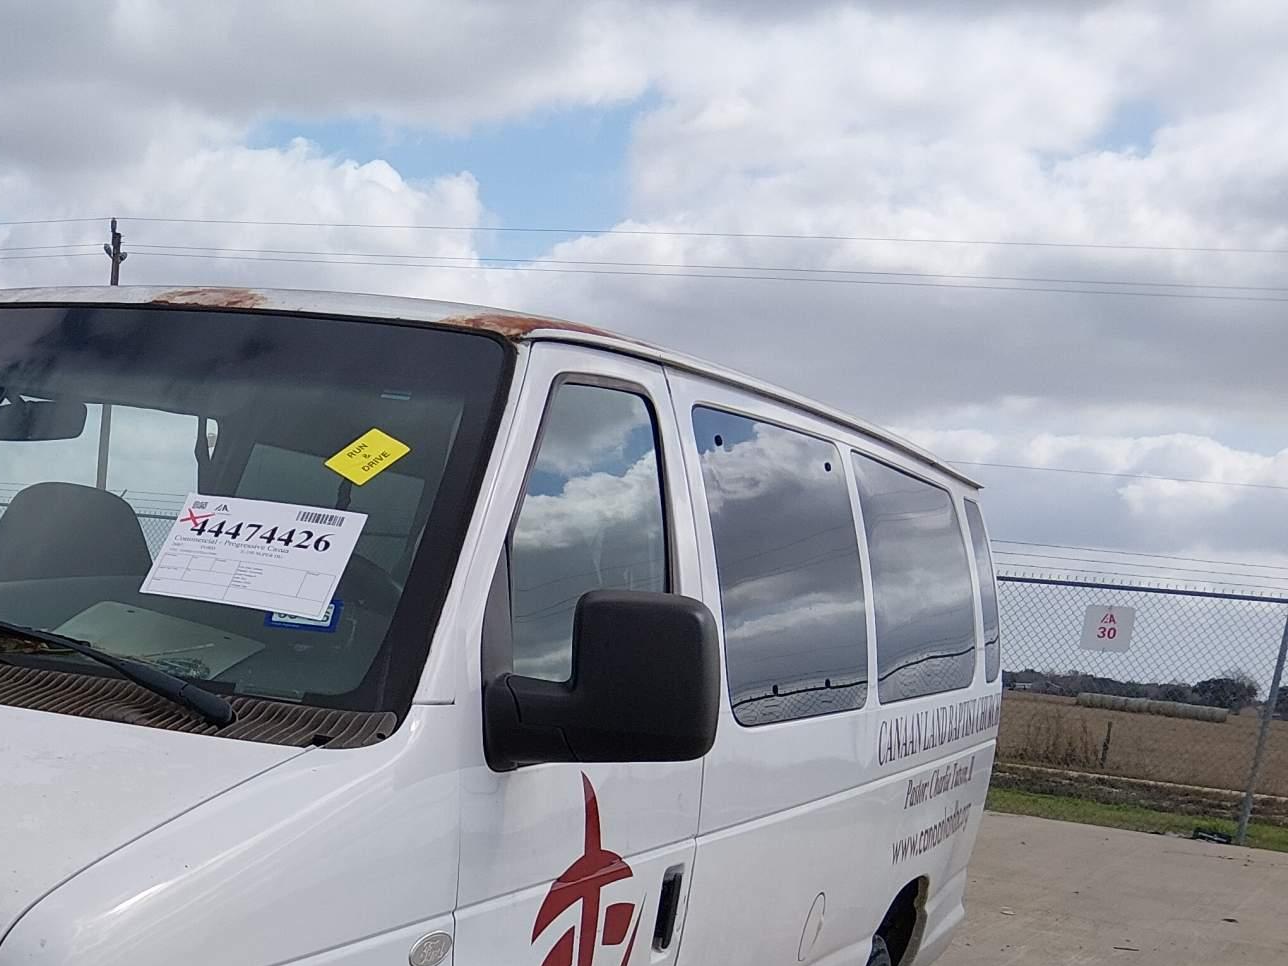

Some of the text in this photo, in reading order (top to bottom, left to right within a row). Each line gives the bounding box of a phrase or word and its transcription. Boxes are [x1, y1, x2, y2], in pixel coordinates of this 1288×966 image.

[346, 442, 369, 459] RUN
[361, 449, 391, 473] DRIVE
[174, 534, 218, 546] Commercial
[224, 538, 266, 552] Progressive
[190, 518, 337, 552] 44474426
[1096, 626, 1117, 640] 30
[904, 779, 930, 810] Pastor:
